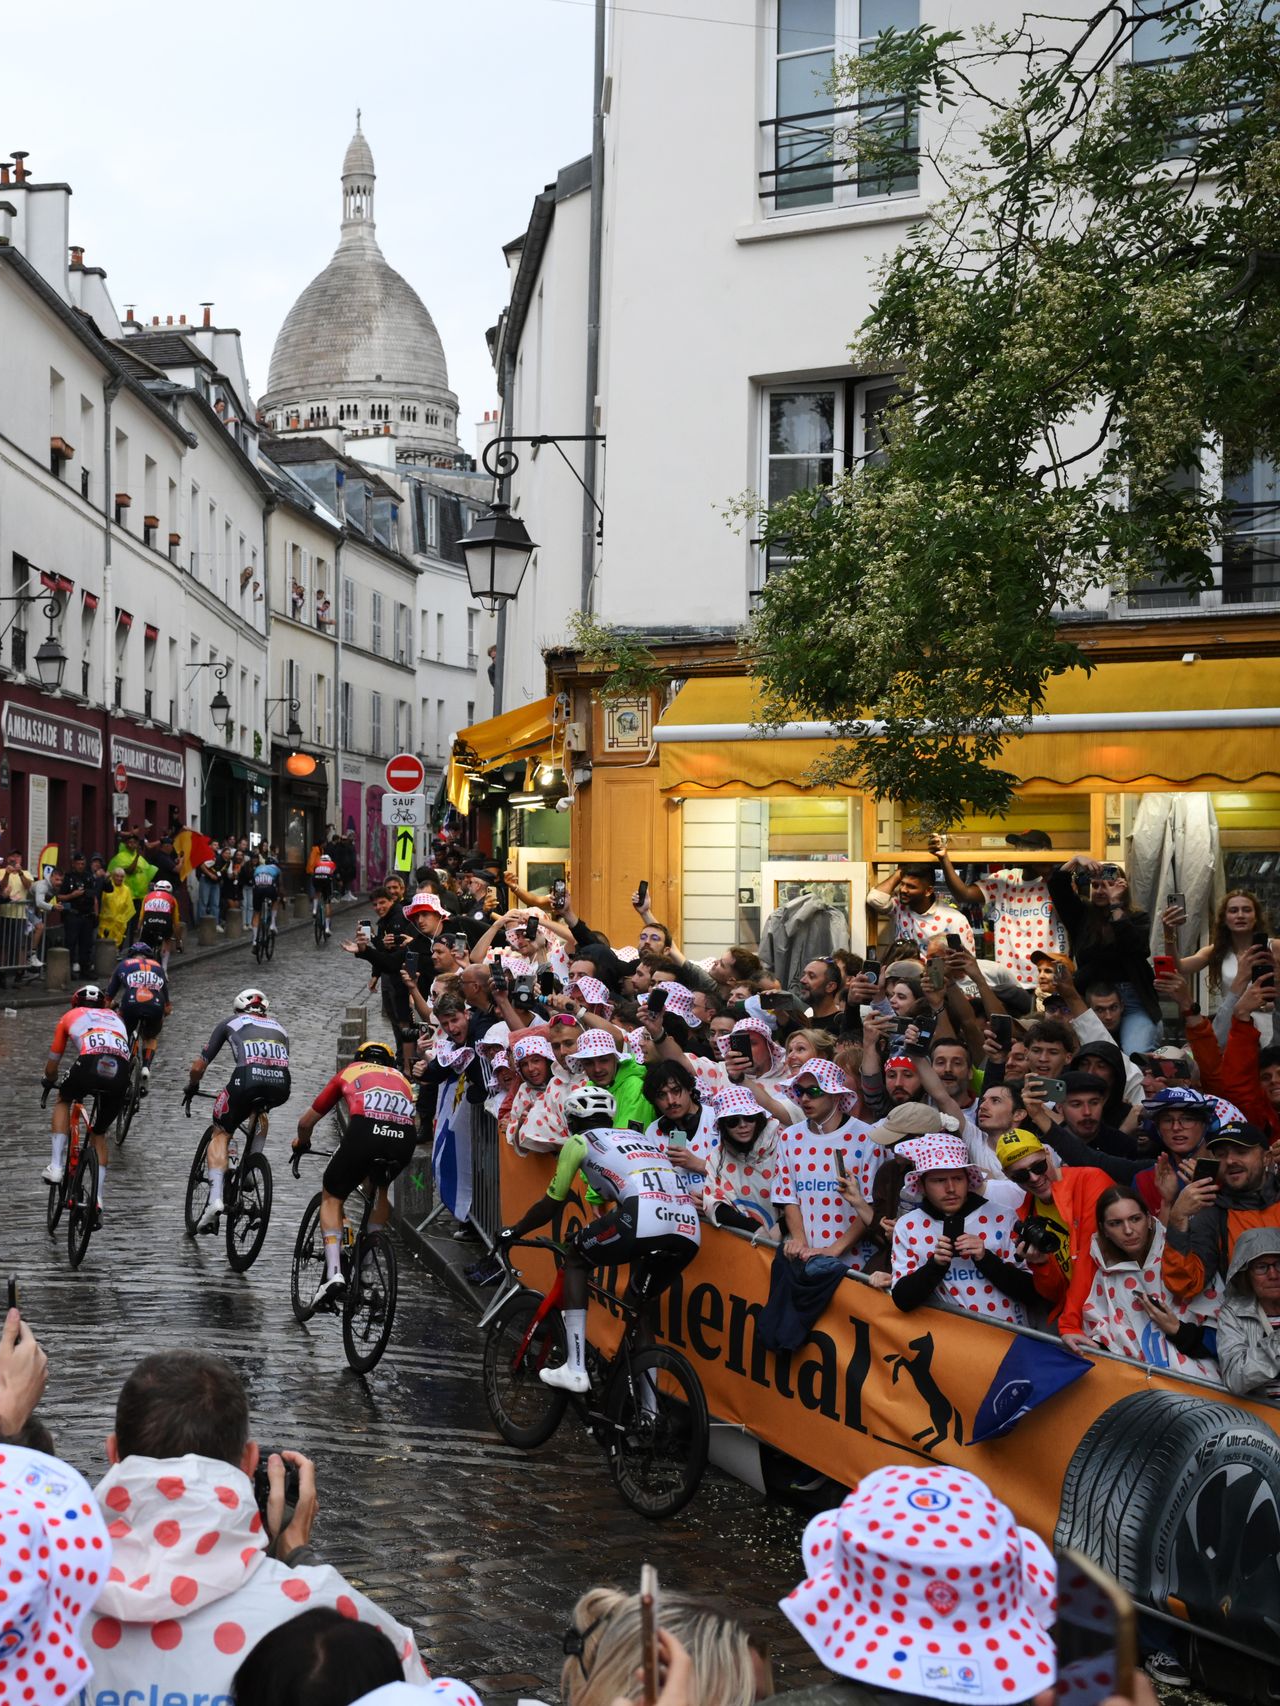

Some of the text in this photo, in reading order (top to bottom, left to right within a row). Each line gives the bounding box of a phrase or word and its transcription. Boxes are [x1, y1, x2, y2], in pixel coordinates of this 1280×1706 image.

[7, 713, 100, 758] AMBASSADE DE SAVOIE
[111, 744, 182, 778] RESTAURANT LE CONSULAT
[392, 798, 415, 806] SAUF
[89, 1035, 106, 1048] 65
[115, 1038, 129, 1054] 65
[246, 1042, 288, 1060] 103 103
[252, 1067, 285, 1078] BRUSTOR
[365, 1092, 391, 1112] 222
[642, 1171, 687, 1194] 41 4
[795, 1177, 838, 1193] eclerc
[655, 1206, 696, 1226] Circus
[943, 1267, 986, 1281] clerc
[1226, 1434, 1274, 1457] UltraContact
